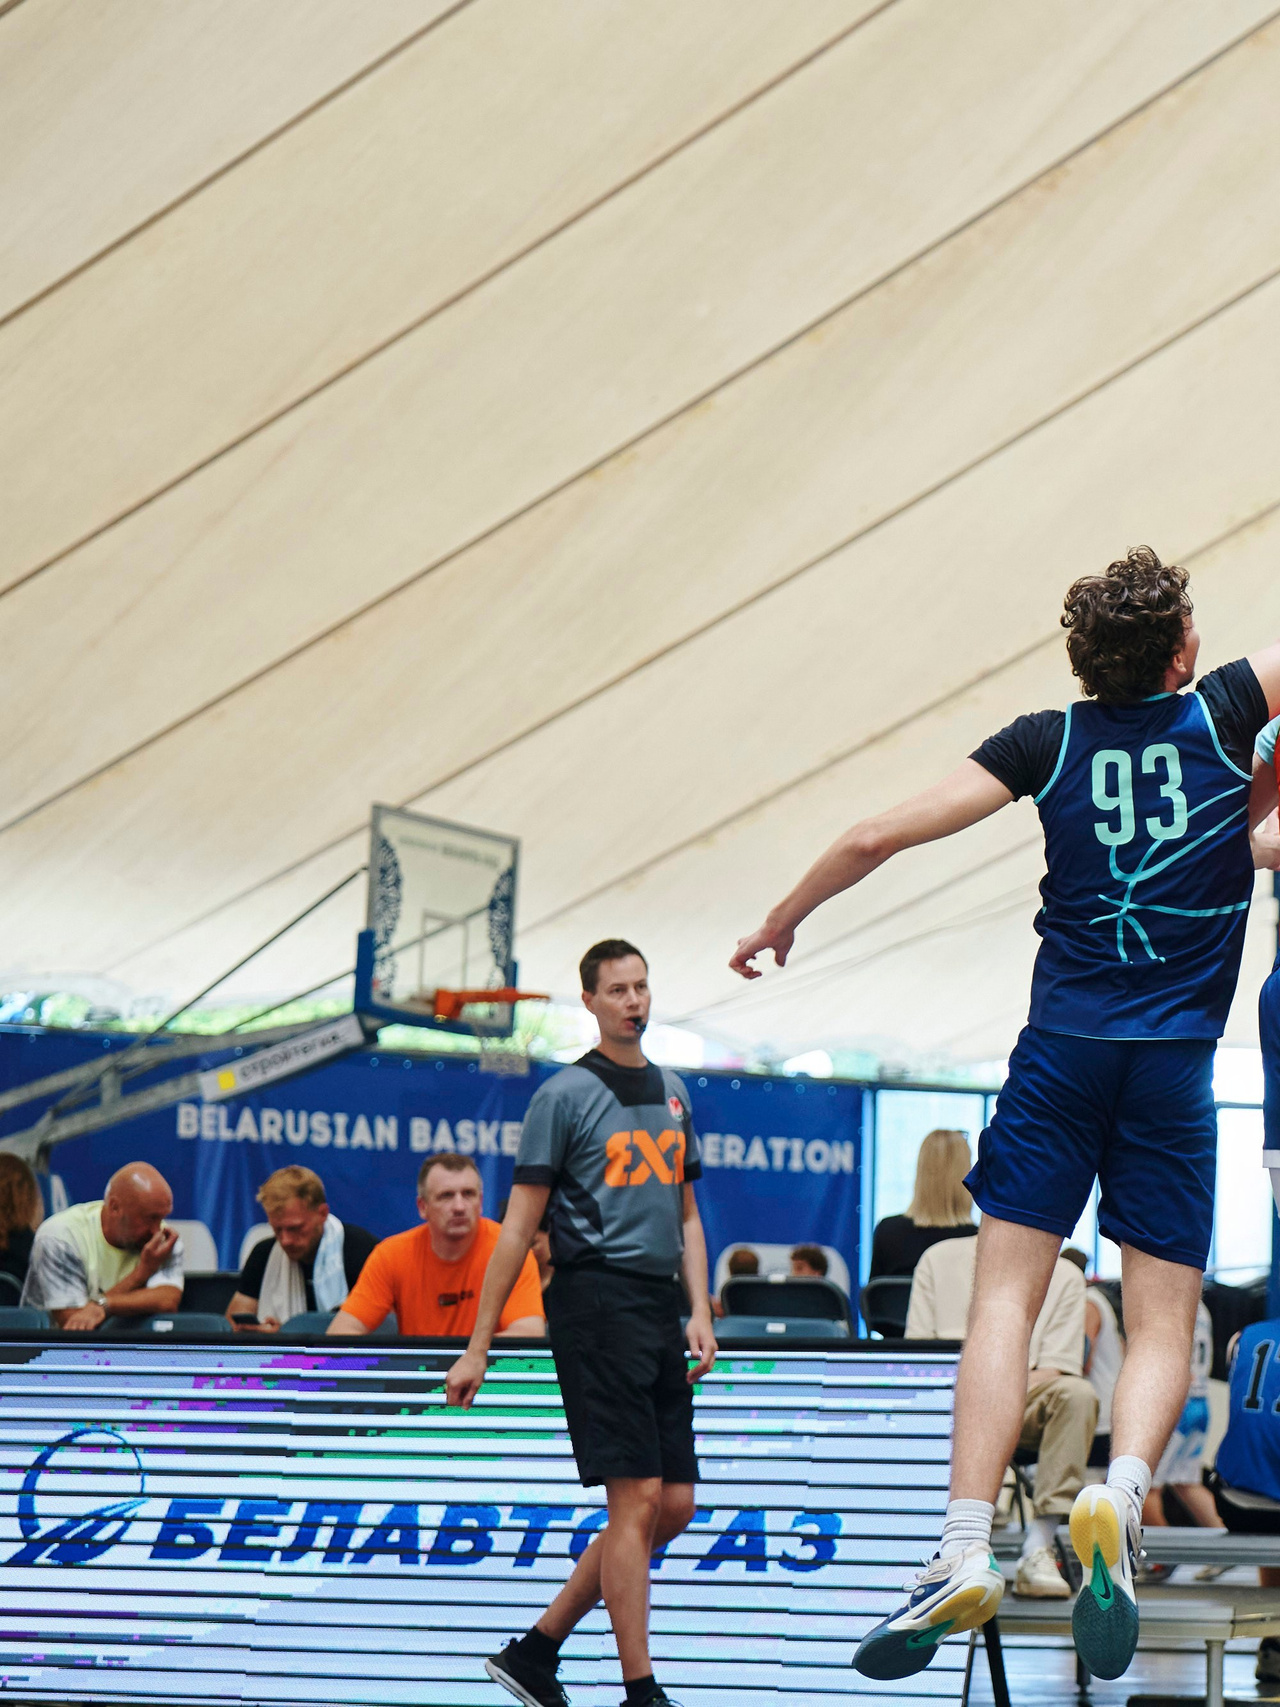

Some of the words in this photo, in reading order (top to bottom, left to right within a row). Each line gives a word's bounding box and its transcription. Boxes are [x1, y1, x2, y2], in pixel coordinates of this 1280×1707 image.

[1092, 743, 1188, 846] 93
[176, 1102, 399, 1151] BELARUSIAN
[409, 1116, 522, 1156] BASKE
[698, 1131, 855, 1174] ERATION
